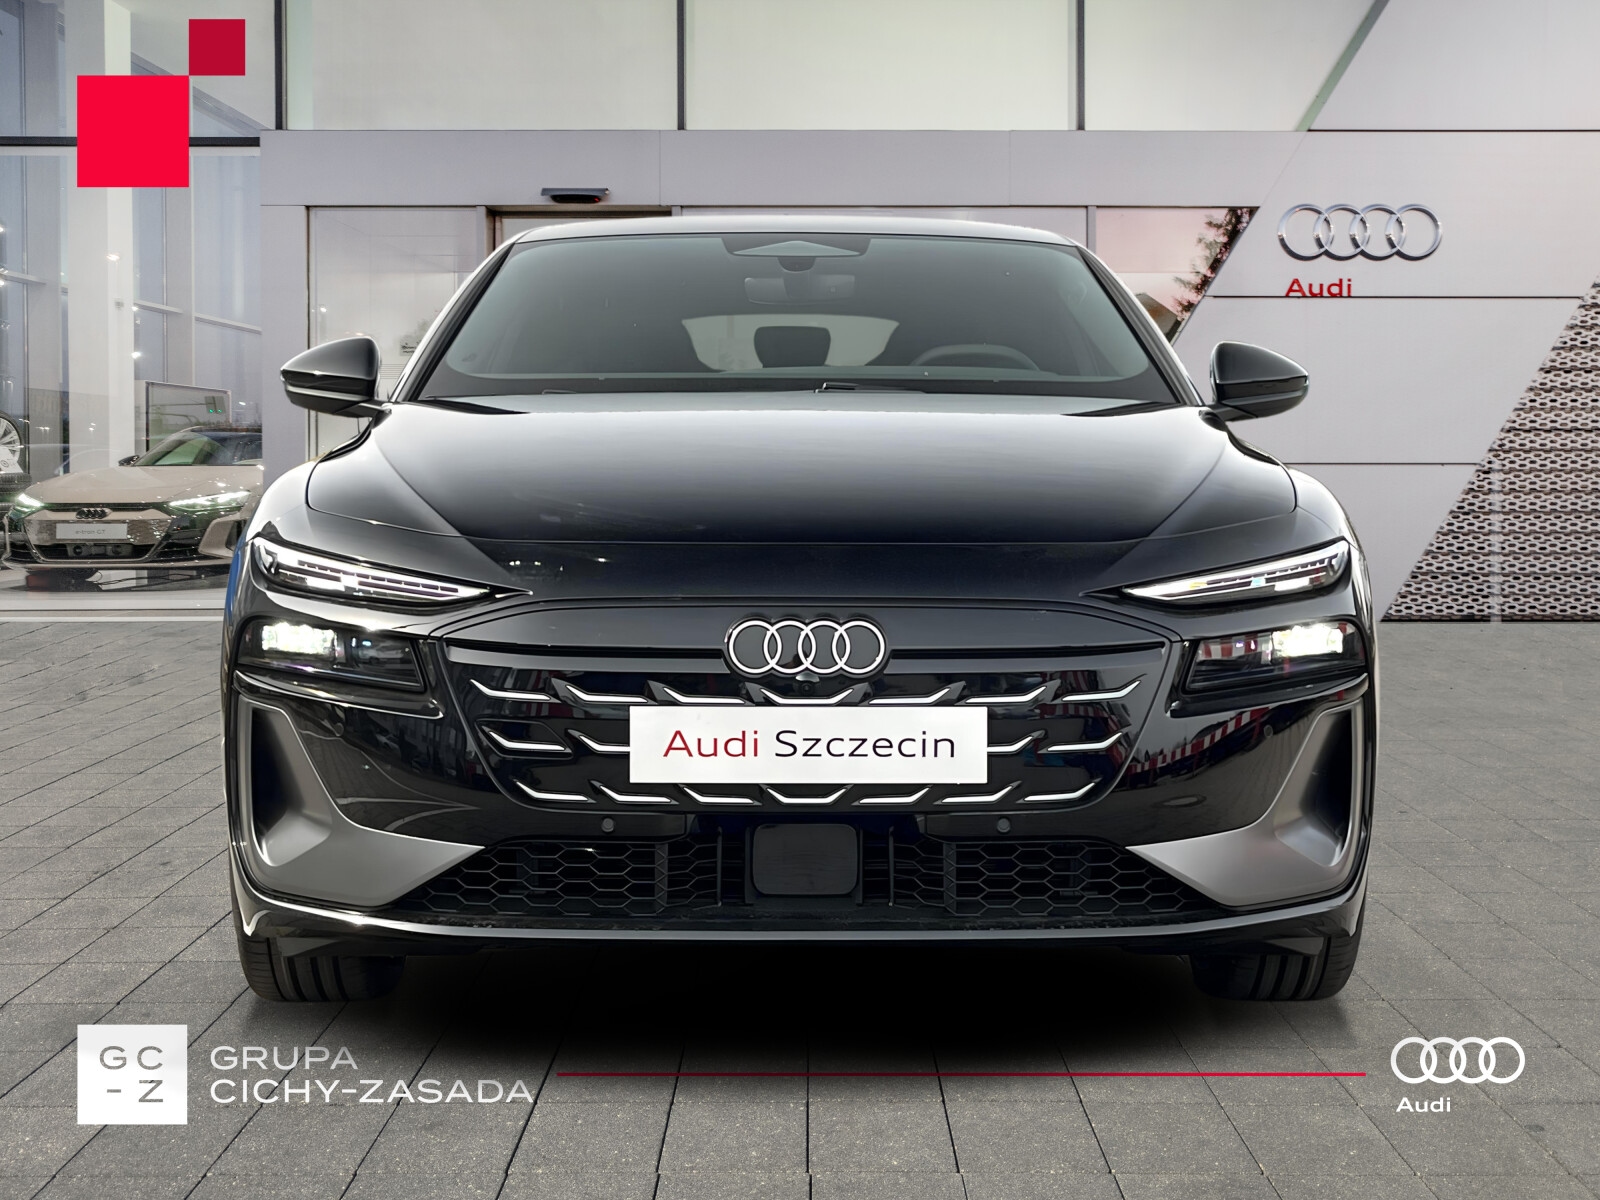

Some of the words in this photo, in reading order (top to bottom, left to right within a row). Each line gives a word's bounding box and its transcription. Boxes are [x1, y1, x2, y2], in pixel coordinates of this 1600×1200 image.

[1285, 278, 1352, 297] Audi
[663, 730, 759, 757] Audi
[774, 730, 955, 758] Szczecin
